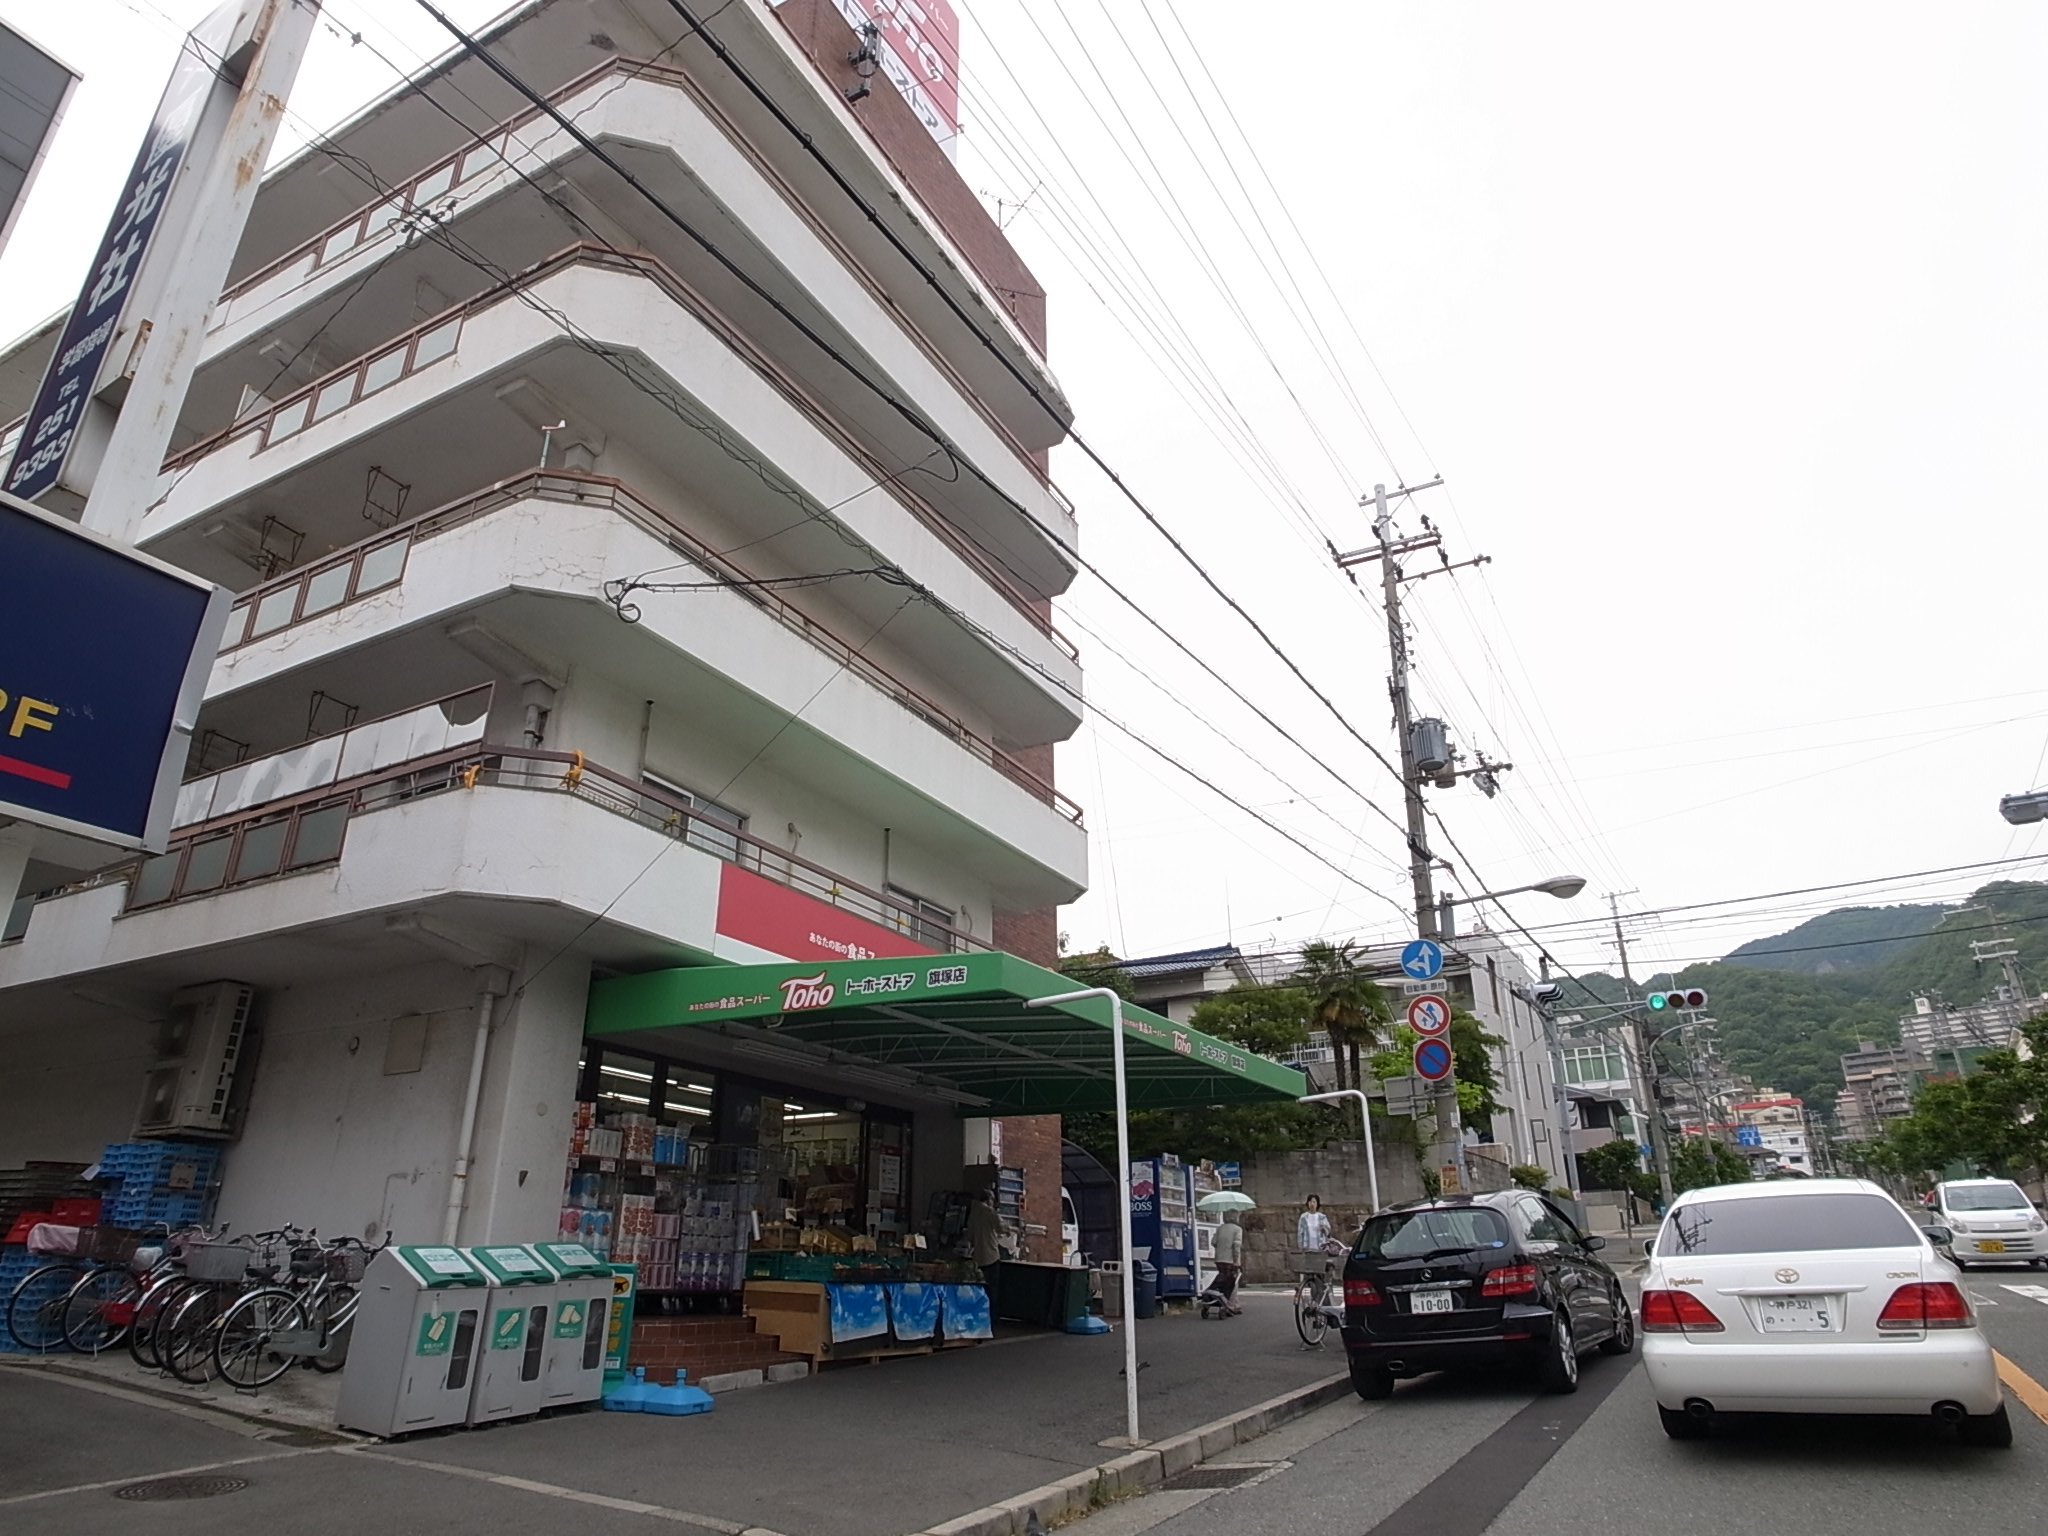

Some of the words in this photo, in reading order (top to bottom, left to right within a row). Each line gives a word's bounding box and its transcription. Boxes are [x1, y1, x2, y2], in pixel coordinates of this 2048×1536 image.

[57, 375, 80, 401] TEL
[31, 394, 79, 448] 251
[9, 428, 72, 491] 9393
[780, 970, 836, 1011] Toho
[846, 973, 916, 995] トーホーストア
[927, 966, 967, 988] 旗塚店
